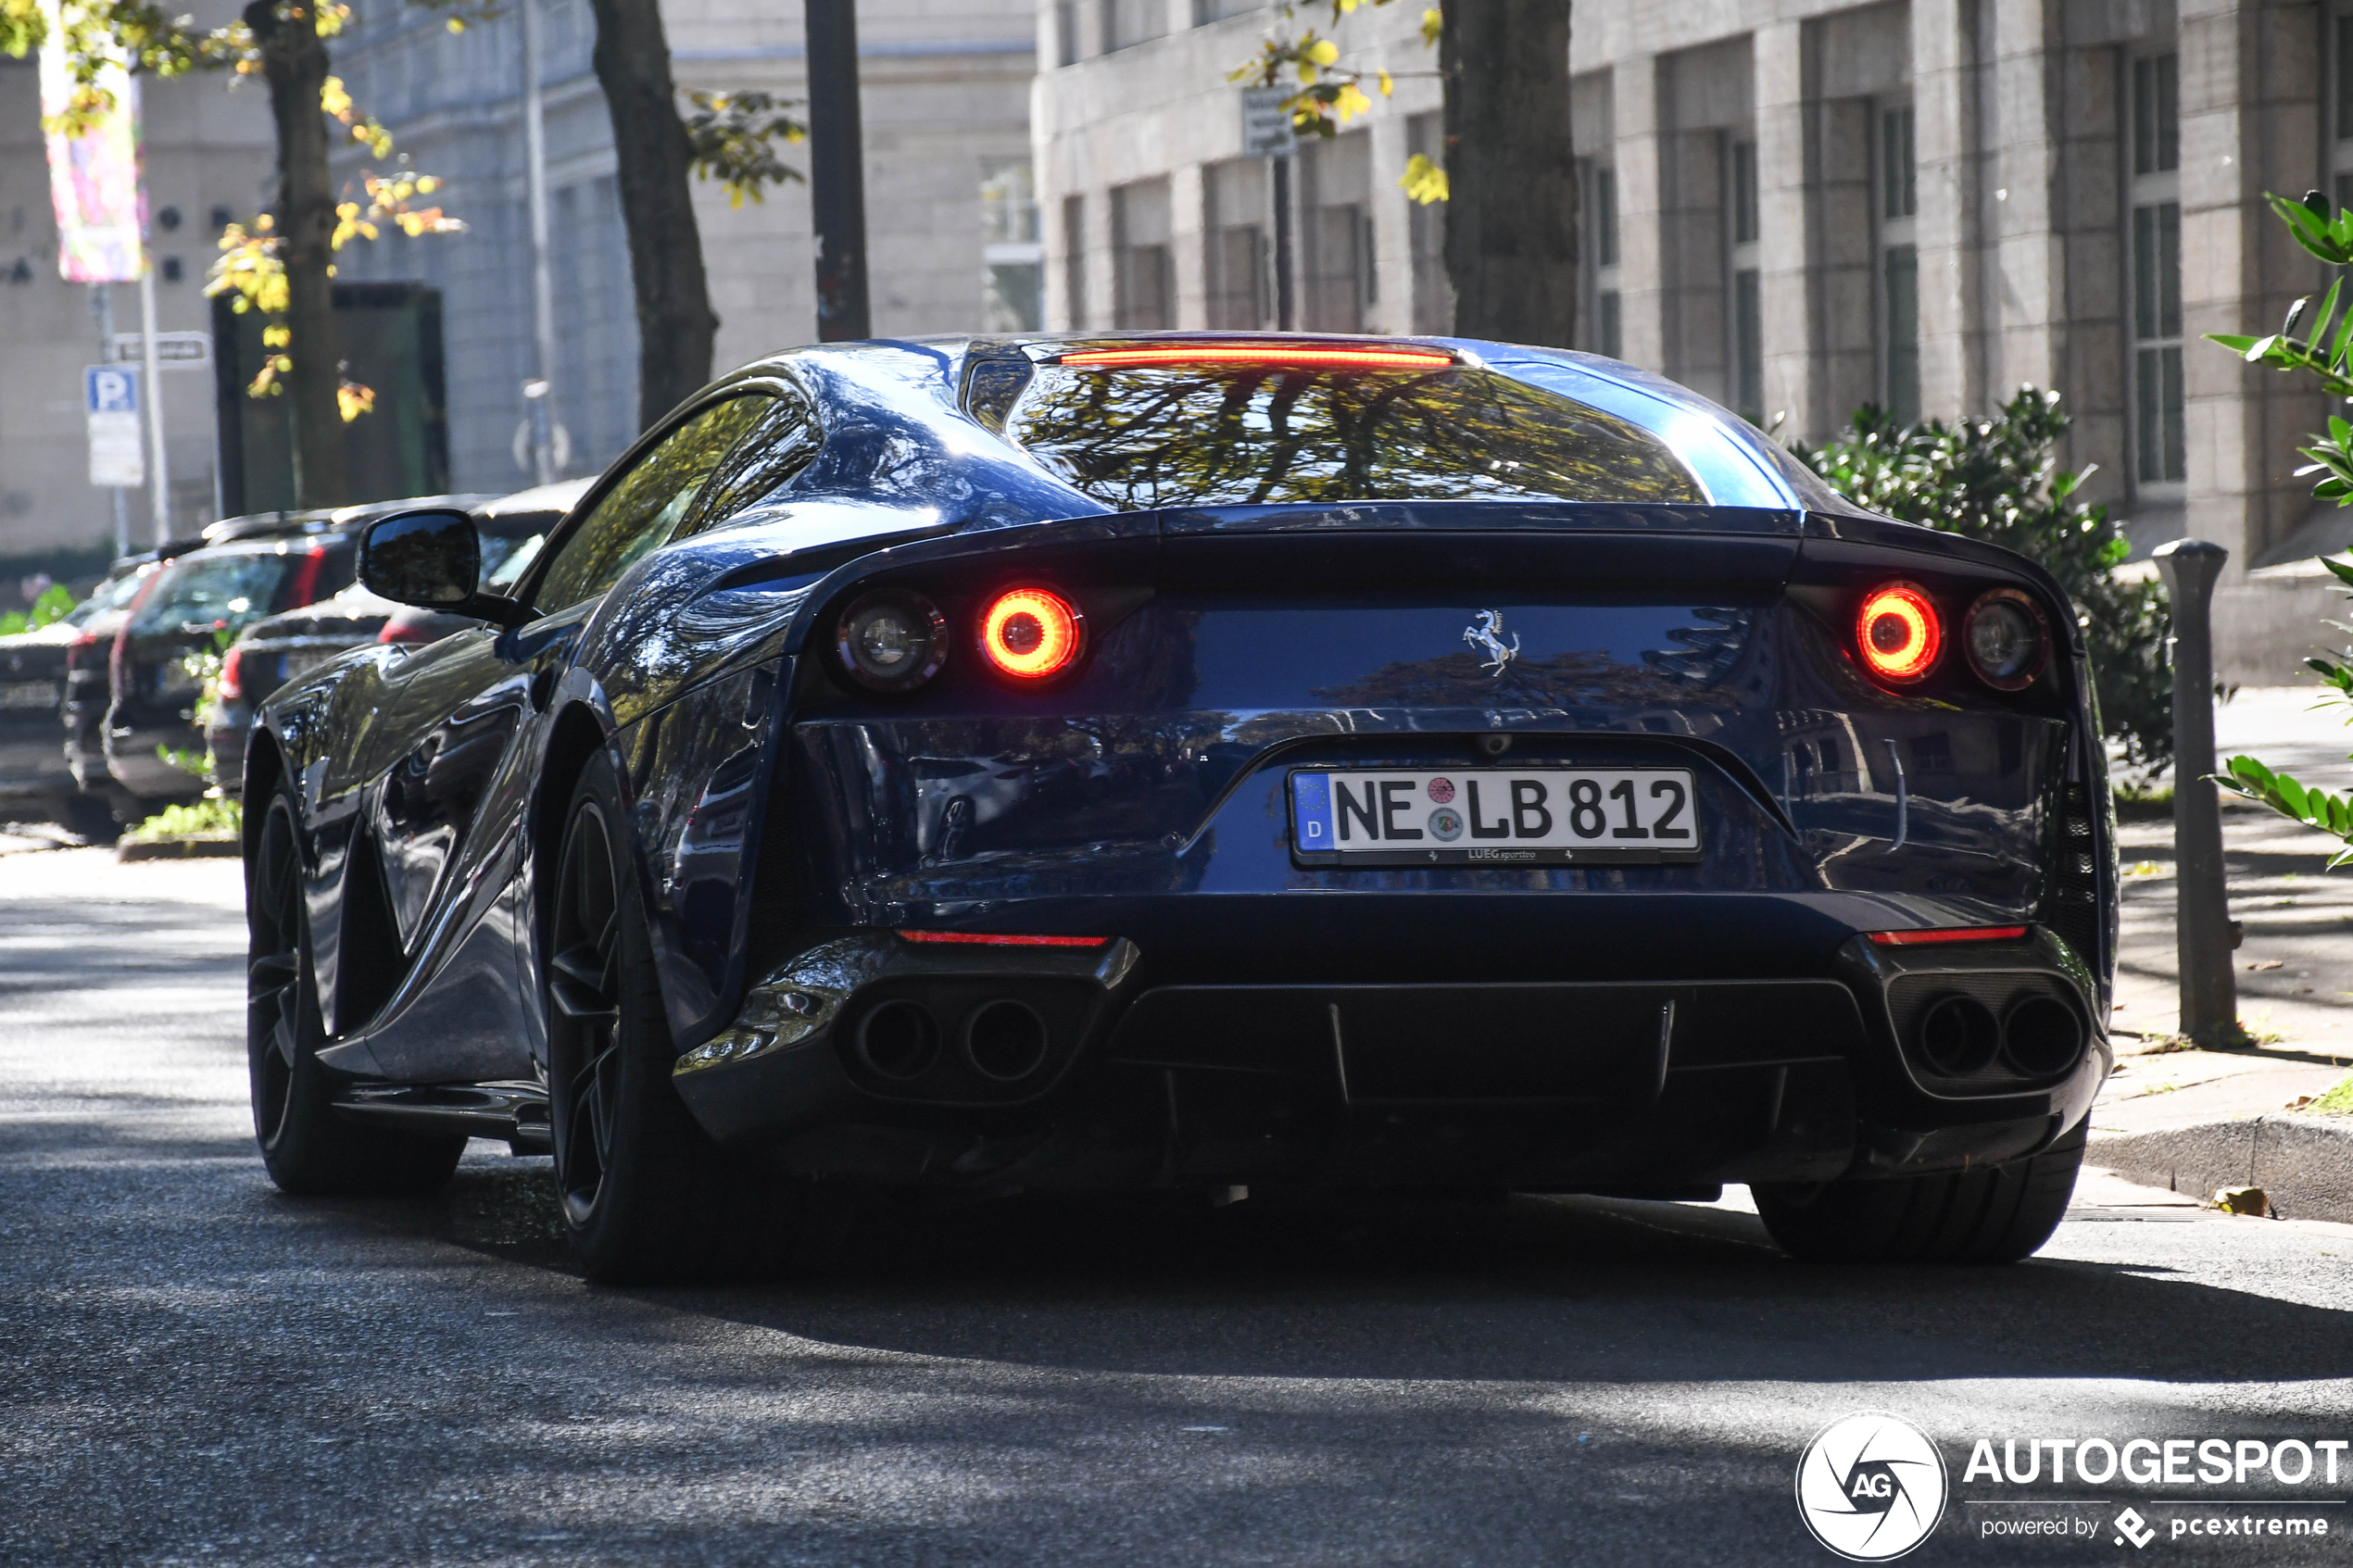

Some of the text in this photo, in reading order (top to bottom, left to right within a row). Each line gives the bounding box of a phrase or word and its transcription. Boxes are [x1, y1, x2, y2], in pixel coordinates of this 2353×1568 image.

[1335, 781, 1424, 841] NE
[1466, 779, 1554, 840] LB
[1568, 779, 1691, 840] 812
[1307, 821, 1322, 838] D
[1468, 848, 1536, 860] LUEG sportivo
